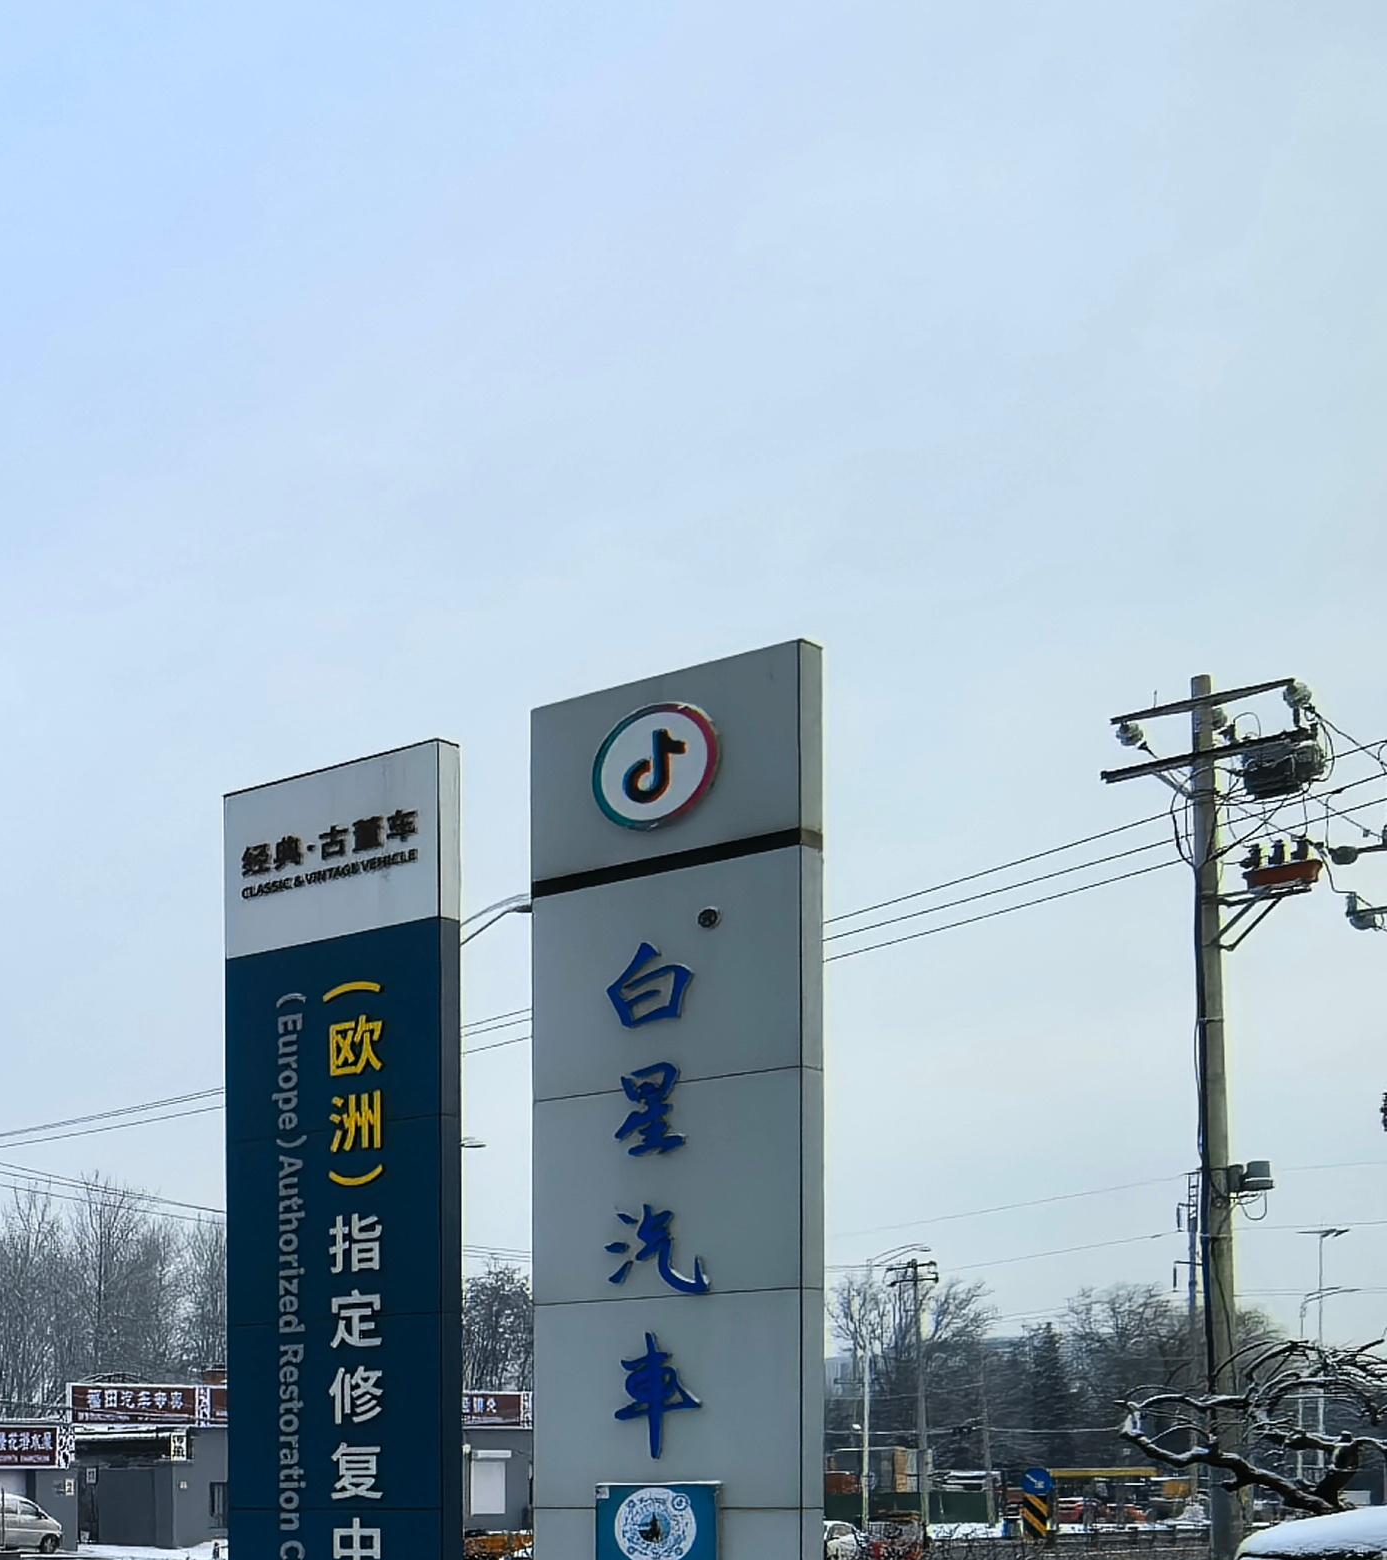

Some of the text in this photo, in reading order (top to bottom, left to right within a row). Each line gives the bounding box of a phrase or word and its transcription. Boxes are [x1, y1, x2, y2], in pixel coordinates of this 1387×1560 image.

[241, 848, 419, 900] CLASSIC & VINTAGE VEHICLE
[278, 1155, 306, 1334] Authorized
[278, 1343, 306, 1531] Restoration
